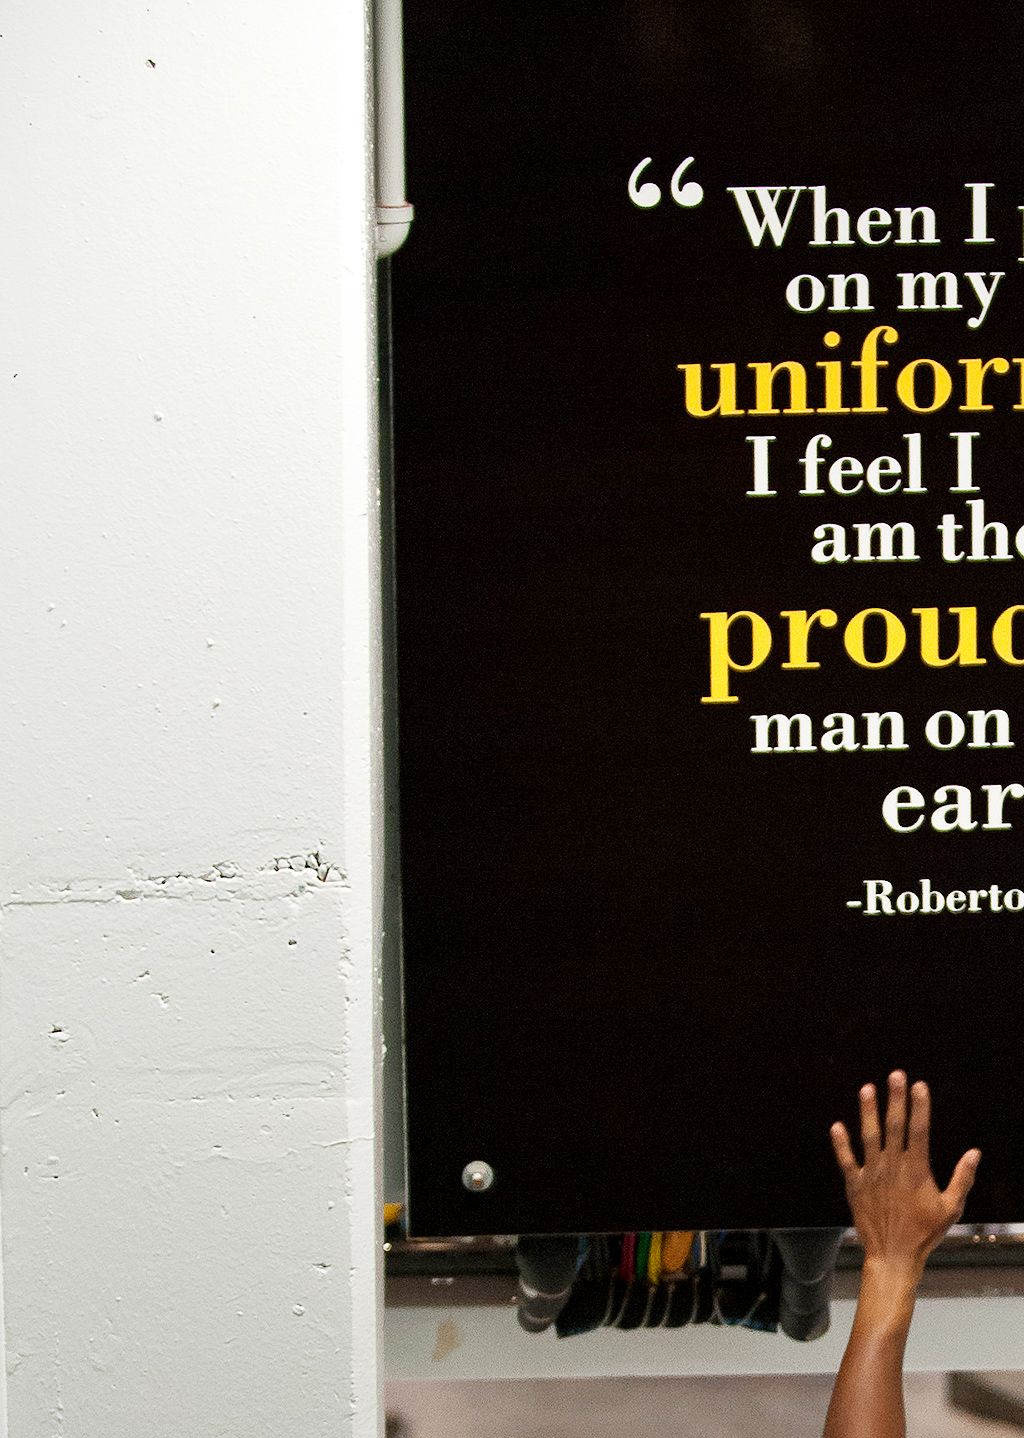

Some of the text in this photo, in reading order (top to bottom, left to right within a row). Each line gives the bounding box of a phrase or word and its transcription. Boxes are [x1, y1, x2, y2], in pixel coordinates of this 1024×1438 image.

[726, 184, 941, 247] When
[964, 182, 996, 243] I
[785, 271, 1006, 329] on my
[745, 431, 981, 497] I feel I
[810, 521, 920, 564] am
[749, 709, 1015, 754] man on
